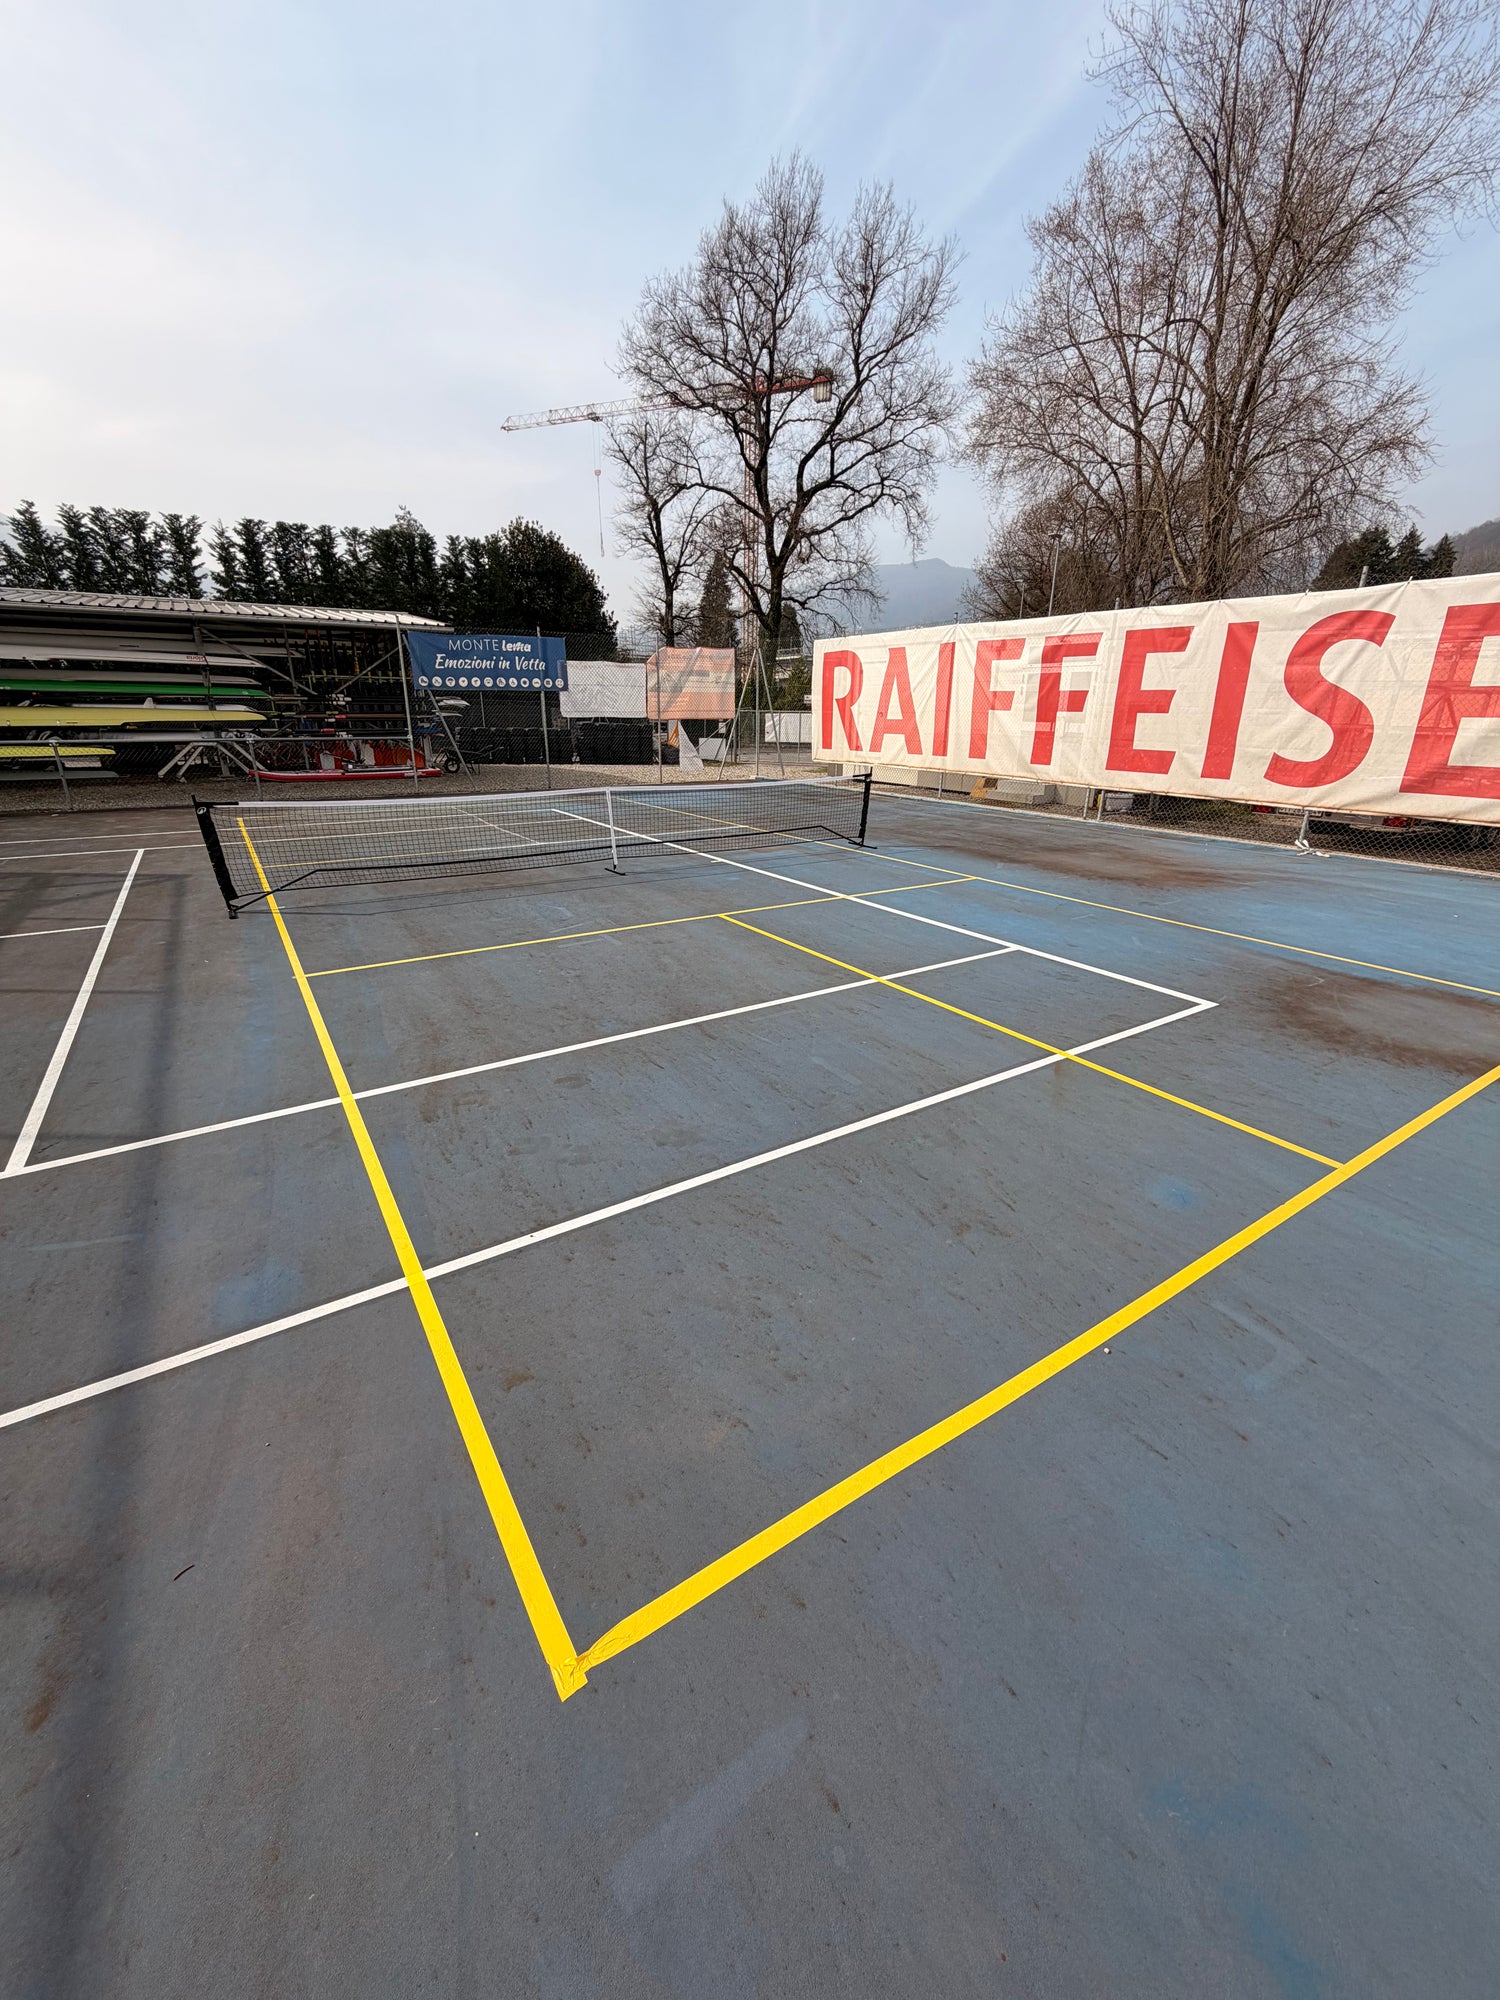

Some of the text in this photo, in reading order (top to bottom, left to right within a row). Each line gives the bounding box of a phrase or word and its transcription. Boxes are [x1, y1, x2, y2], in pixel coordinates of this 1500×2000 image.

[448, 639, 532, 652] MONTE lema
[434, 653, 546, 670] Emozioni in Vetta
[821, 602, 1500, 798] RAIFFEISE
